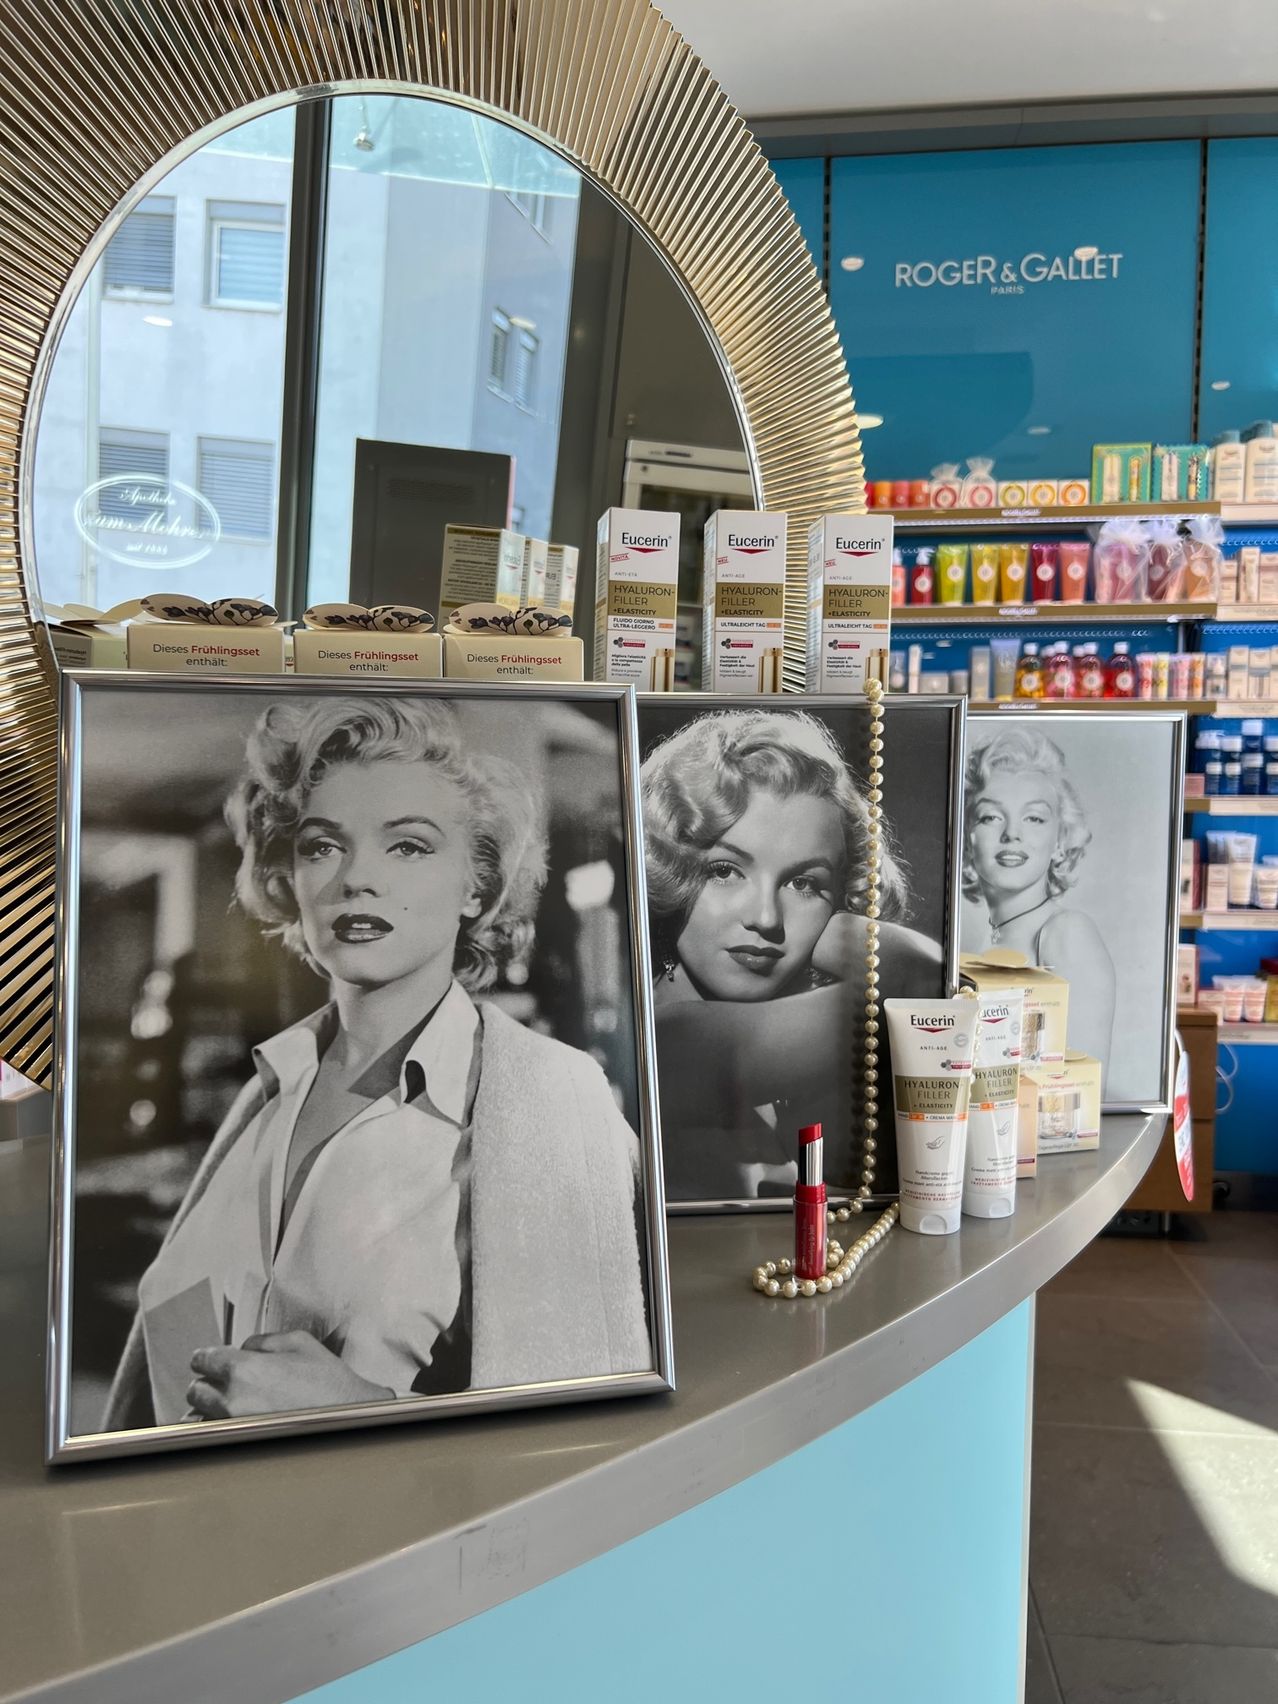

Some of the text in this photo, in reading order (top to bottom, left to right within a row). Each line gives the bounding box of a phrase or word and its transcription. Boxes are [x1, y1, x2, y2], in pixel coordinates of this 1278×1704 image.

[991, 285, 1024, 295] PARIS
[622, 532, 668, 547] Eucerin
[728, 534, 775, 547] Eucerin
[836, 537, 881, 550] Eucerin
[614, 585, 675, 597] HYALURON-
[721, 587, 782, 596] HYALURON-
[829, 589, 888, 598] HYALURON-
[614, 596, 648, 606] FILLER
[721, 598, 756, 606] FILLER
[829, 600, 862, 608] FILLER
[613, 623, 656, 631] ULTRA-LEGGERO
[153, 643, 260, 657] Dieses Frühlingsset
[186, 656, 228, 667] enthält:
[318, 650, 419, 663] Dieses Frühlingsset
[467, 653, 562, 666] Dieses Frühlingsset
[349, 662, 389, 673] enthält:
[496, 665, 534, 676] enthält:
[910, 1015, 955, 1027] Eucerin
[987, 1078, 1012, 1089] FILLER
[917, 1090, 951, 1100] FILLER
